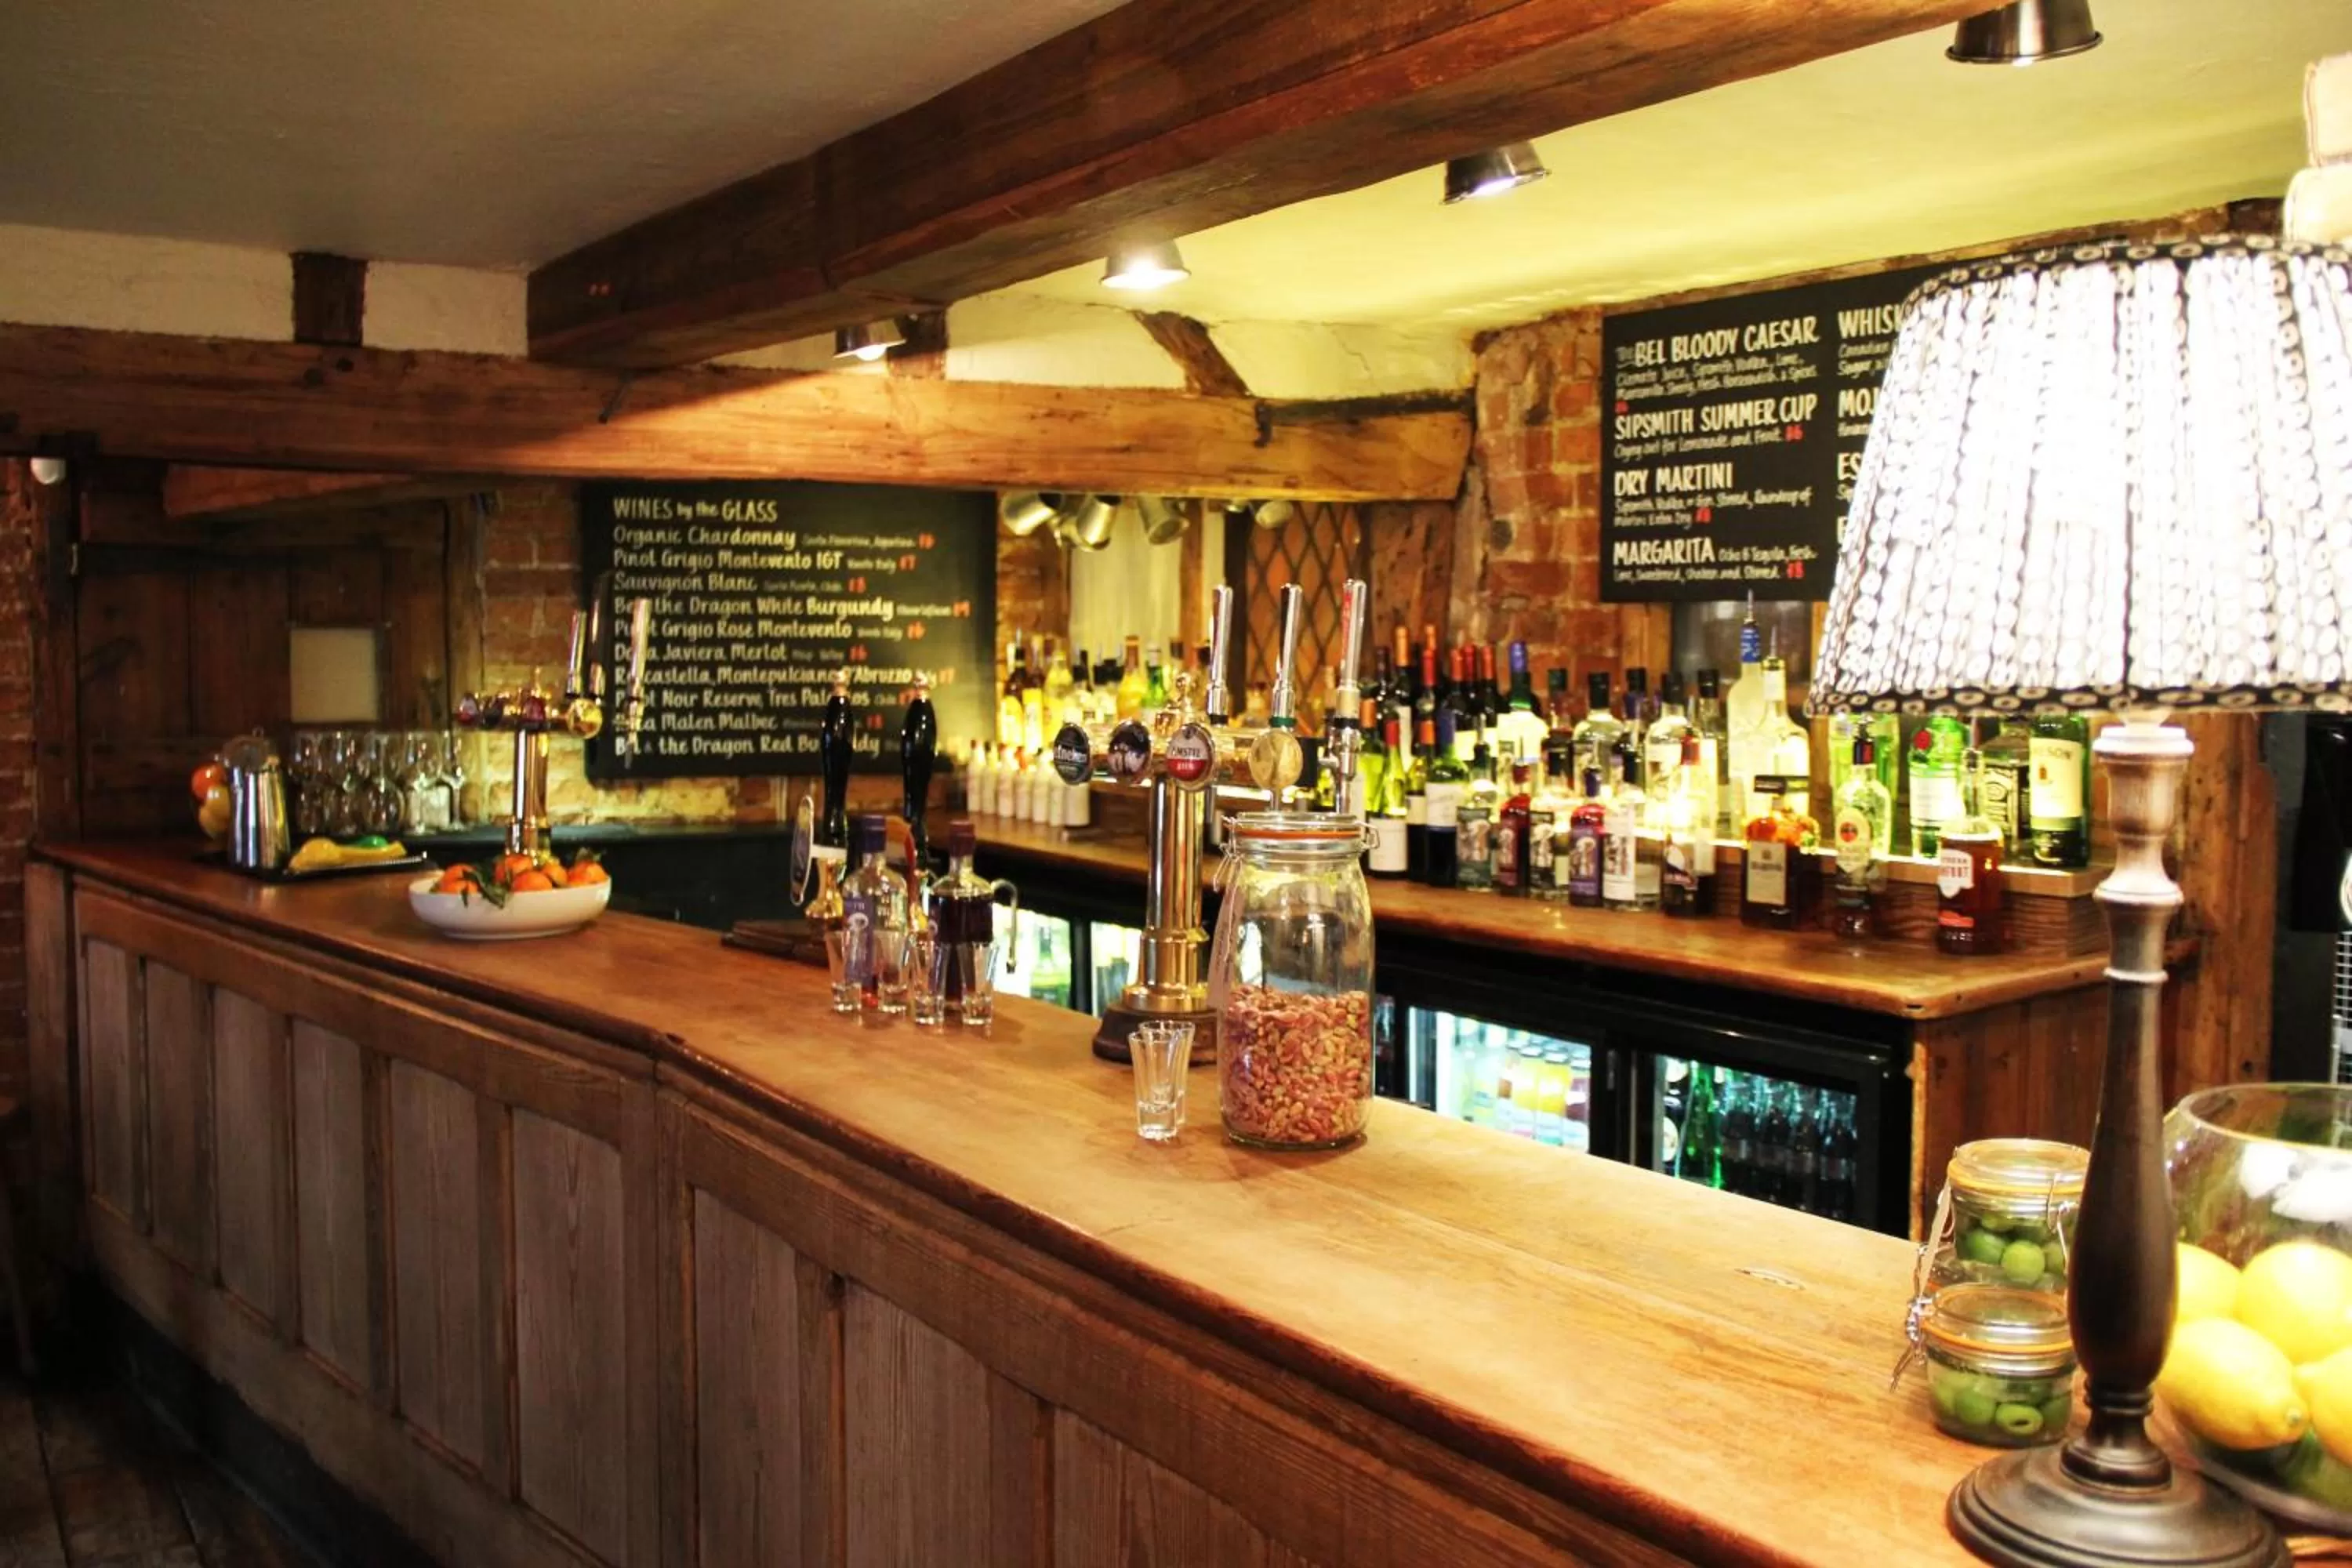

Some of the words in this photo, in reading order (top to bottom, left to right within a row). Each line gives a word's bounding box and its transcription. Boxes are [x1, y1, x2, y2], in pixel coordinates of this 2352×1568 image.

[1838, 303, 1905, 339] WHISK
[1635, 339, 1668, 367] BEL
[1671, 328, 1739, 363] BLOODY
[1744, 315, 1820, 352] CAESAR
[1838, 386, 1882, 419] MOJ
[1614, 408, 1694, 440] SIPSMITH
[1700, 397, 1779, 432] SUMMER
[1779, 393, 1818, 423] CUP
[1613, 470, 1649, 497] DRY
[1655, 462, 1734, 494] MARTINI
[613, 498, 674, 520] WINES
[677, 503, 694, 521] by
[695, 501, 719, 517] the
[721, 499, 779, 522] GLASS
[613, 525, 682, 549] Organic
[688, 526, 797, 550] Chardonnay
[613, 549, 656, 568] Pinot
[661, 550, 713, 575] Grigio
[717, 550, 813, 570] Montevento
[815, 550, 844, 571] IGT
[1613, 537, 1716, 565] MARGARITA
[613, 572, 703, 596] Sauvignon
[707, 572, 759, 592] Blanc
[654, 594, 684, 615] the
[689, 597, 753, 620] Dragon
[756, 597, 804, 615] White
[805, 596, 895, 622] Burgundy
[614, 619, 658, 638] Pit
[661, 619, 713, 642] Grigio
[757, 619, 853, 639] Montevento
[614, 643, 659, 662] Doa
[662, 642, 726, 662] Javiera
[731, 641, 788, 662] Merlot
[614, 666, 717, 687] Rocastella,
[614, 689, 656, 707] Pot
[662, 689, 699, 707] Noir
[768, 688, 797, 707] Tres
[801, 687, 870, 707] Palaos
[661, 713, 715, 731] Malen
[718, 713, 779, 731] Malbec
[615, 735, 641, 757] Bl
[659, 735, 688, 755] the
[692, 735, 754, 760] Dragon
[760, 735, 795, 755] Red
